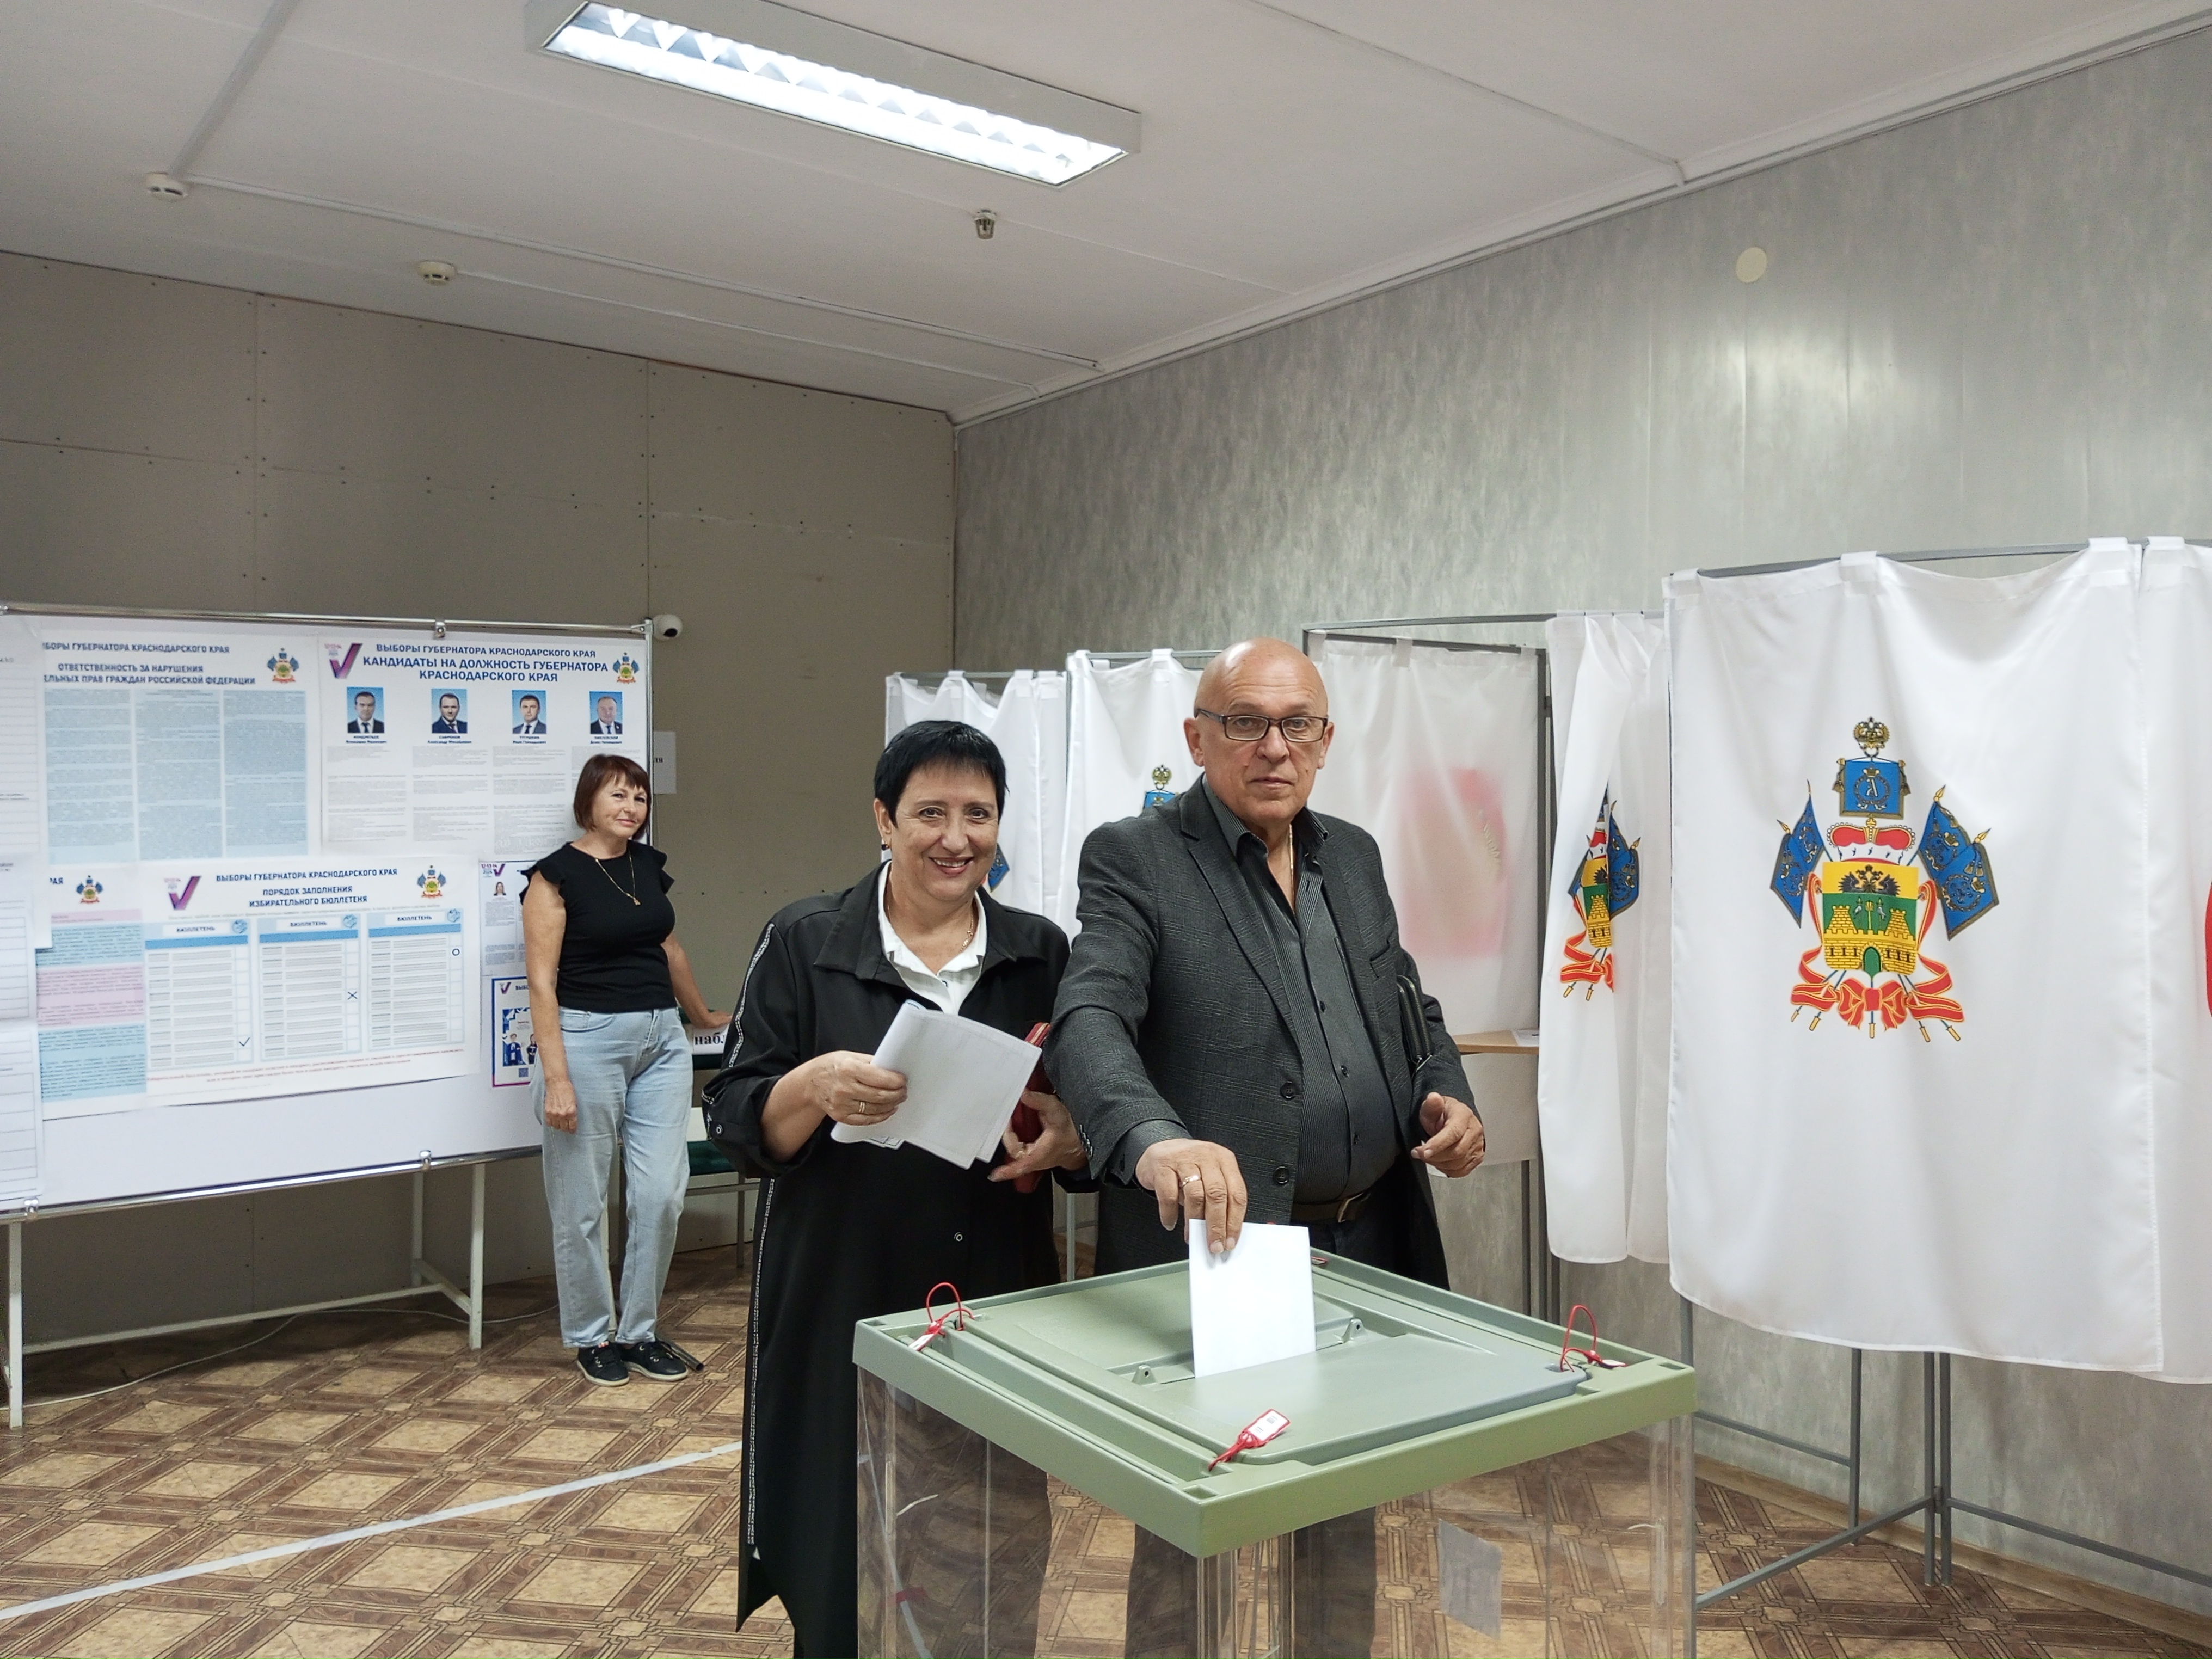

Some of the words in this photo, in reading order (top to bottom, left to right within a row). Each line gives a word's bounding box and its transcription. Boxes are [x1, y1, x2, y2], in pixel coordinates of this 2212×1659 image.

[72, 643, 130, 651] ГУБЕРНАТОРА
[132, 644, 207, 653] КРАСНОДАРСКОГО
[377, 644, 420, 652] ВЫБОРЫ
[423, 646, 487, 654] ГУБЕРНАТОРА
[489, 647, 570, 657] КРАСНОДАРСКОГО
[58, 663, 137, 672] ОТВЕТСТВЕННОСТЬ
[152, 665, 204, 673] НАРУШЕНИЯ
[363, 656, 437, 668] КАНДИДАТЫ
[441, 659, 457, 668] НА
[459, 659, 530, 669] ДОЛЖНОСТЬ
[533, 661, 608, 672] ГУБЕРНАТОРА
[106, 675, 146, 684] ГРАЖДАН
[148, 675, 204, 684] РОССИЙСКОЙ
[205, 677, 255, 685] ФЕДЕРАЦИИ
[420, 670, 525, 681] КРАСНОДАРСКОГО
[529, 673, 558, 682] КРАЯ
[254, 872, 306, 881] ГУБЕРНАТОРА
[309, 870, 377, 879] КРАСНОДАРСКОГО
[263, 888, 300, 896] ПОРЯДОК
[302, 886, 353, 895] ЗАПОЛНЕНИЯ
[249, 898, 319, 908] ИЗБИРАТЕЛЬНОГО
[321, 896, 367, 905] БЮЛЛЕТЕНЯ
